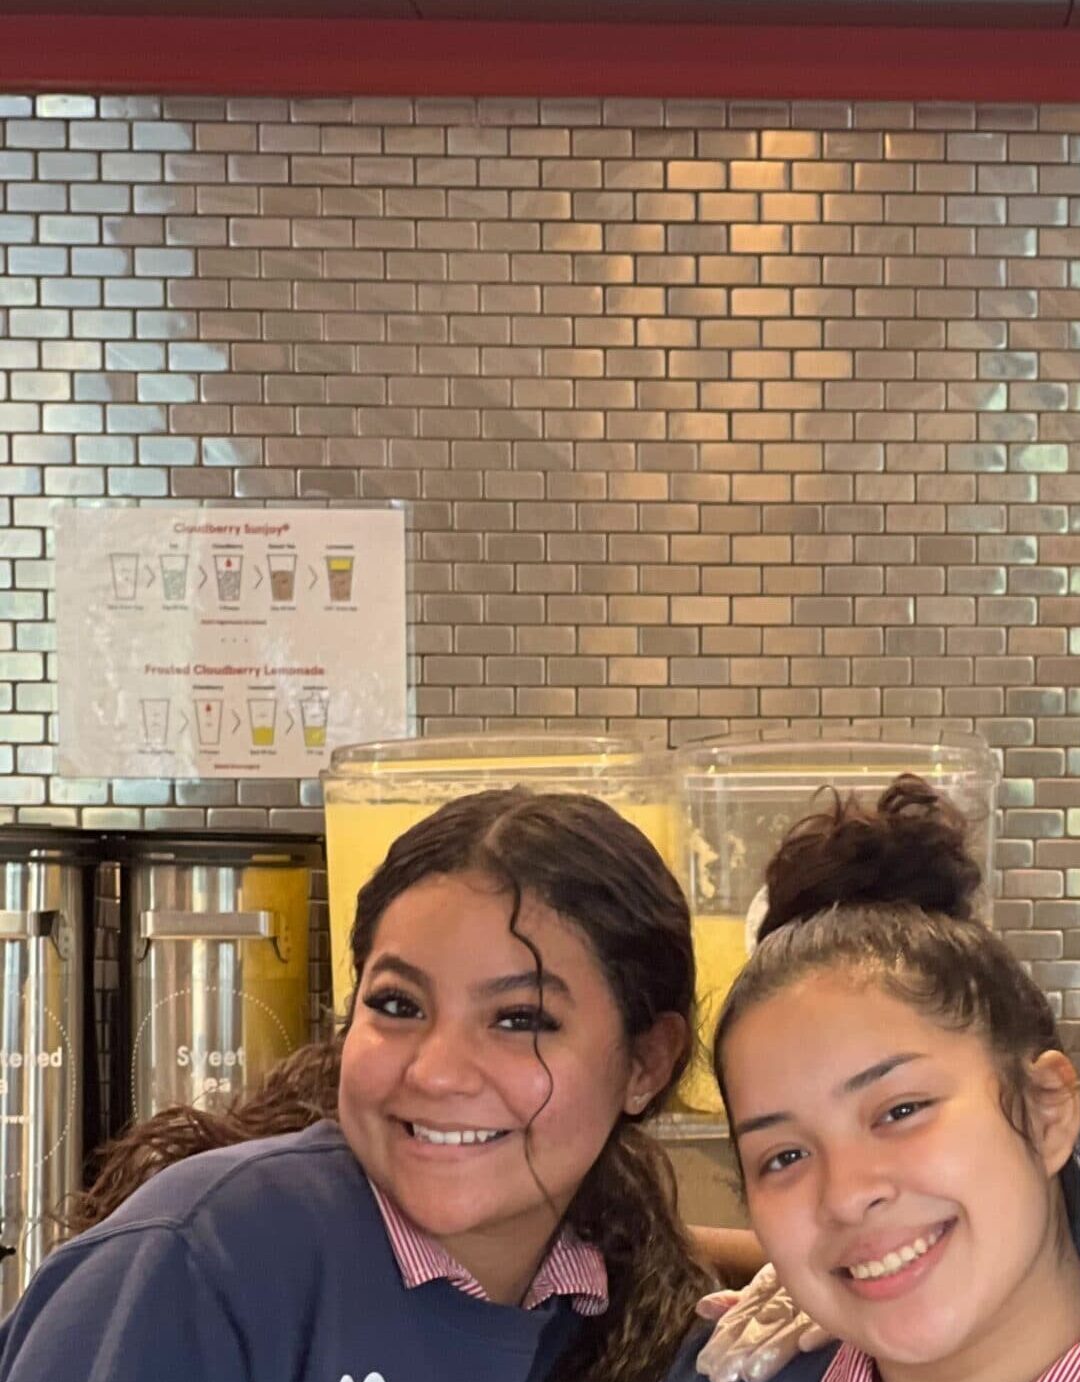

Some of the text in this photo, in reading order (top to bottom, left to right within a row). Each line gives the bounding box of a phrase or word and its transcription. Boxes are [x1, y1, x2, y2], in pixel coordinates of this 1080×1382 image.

[145, 664, 325, 677] Frosted Cloudberry Lemonade
[177, 1046, 246, 1067] Sweet
